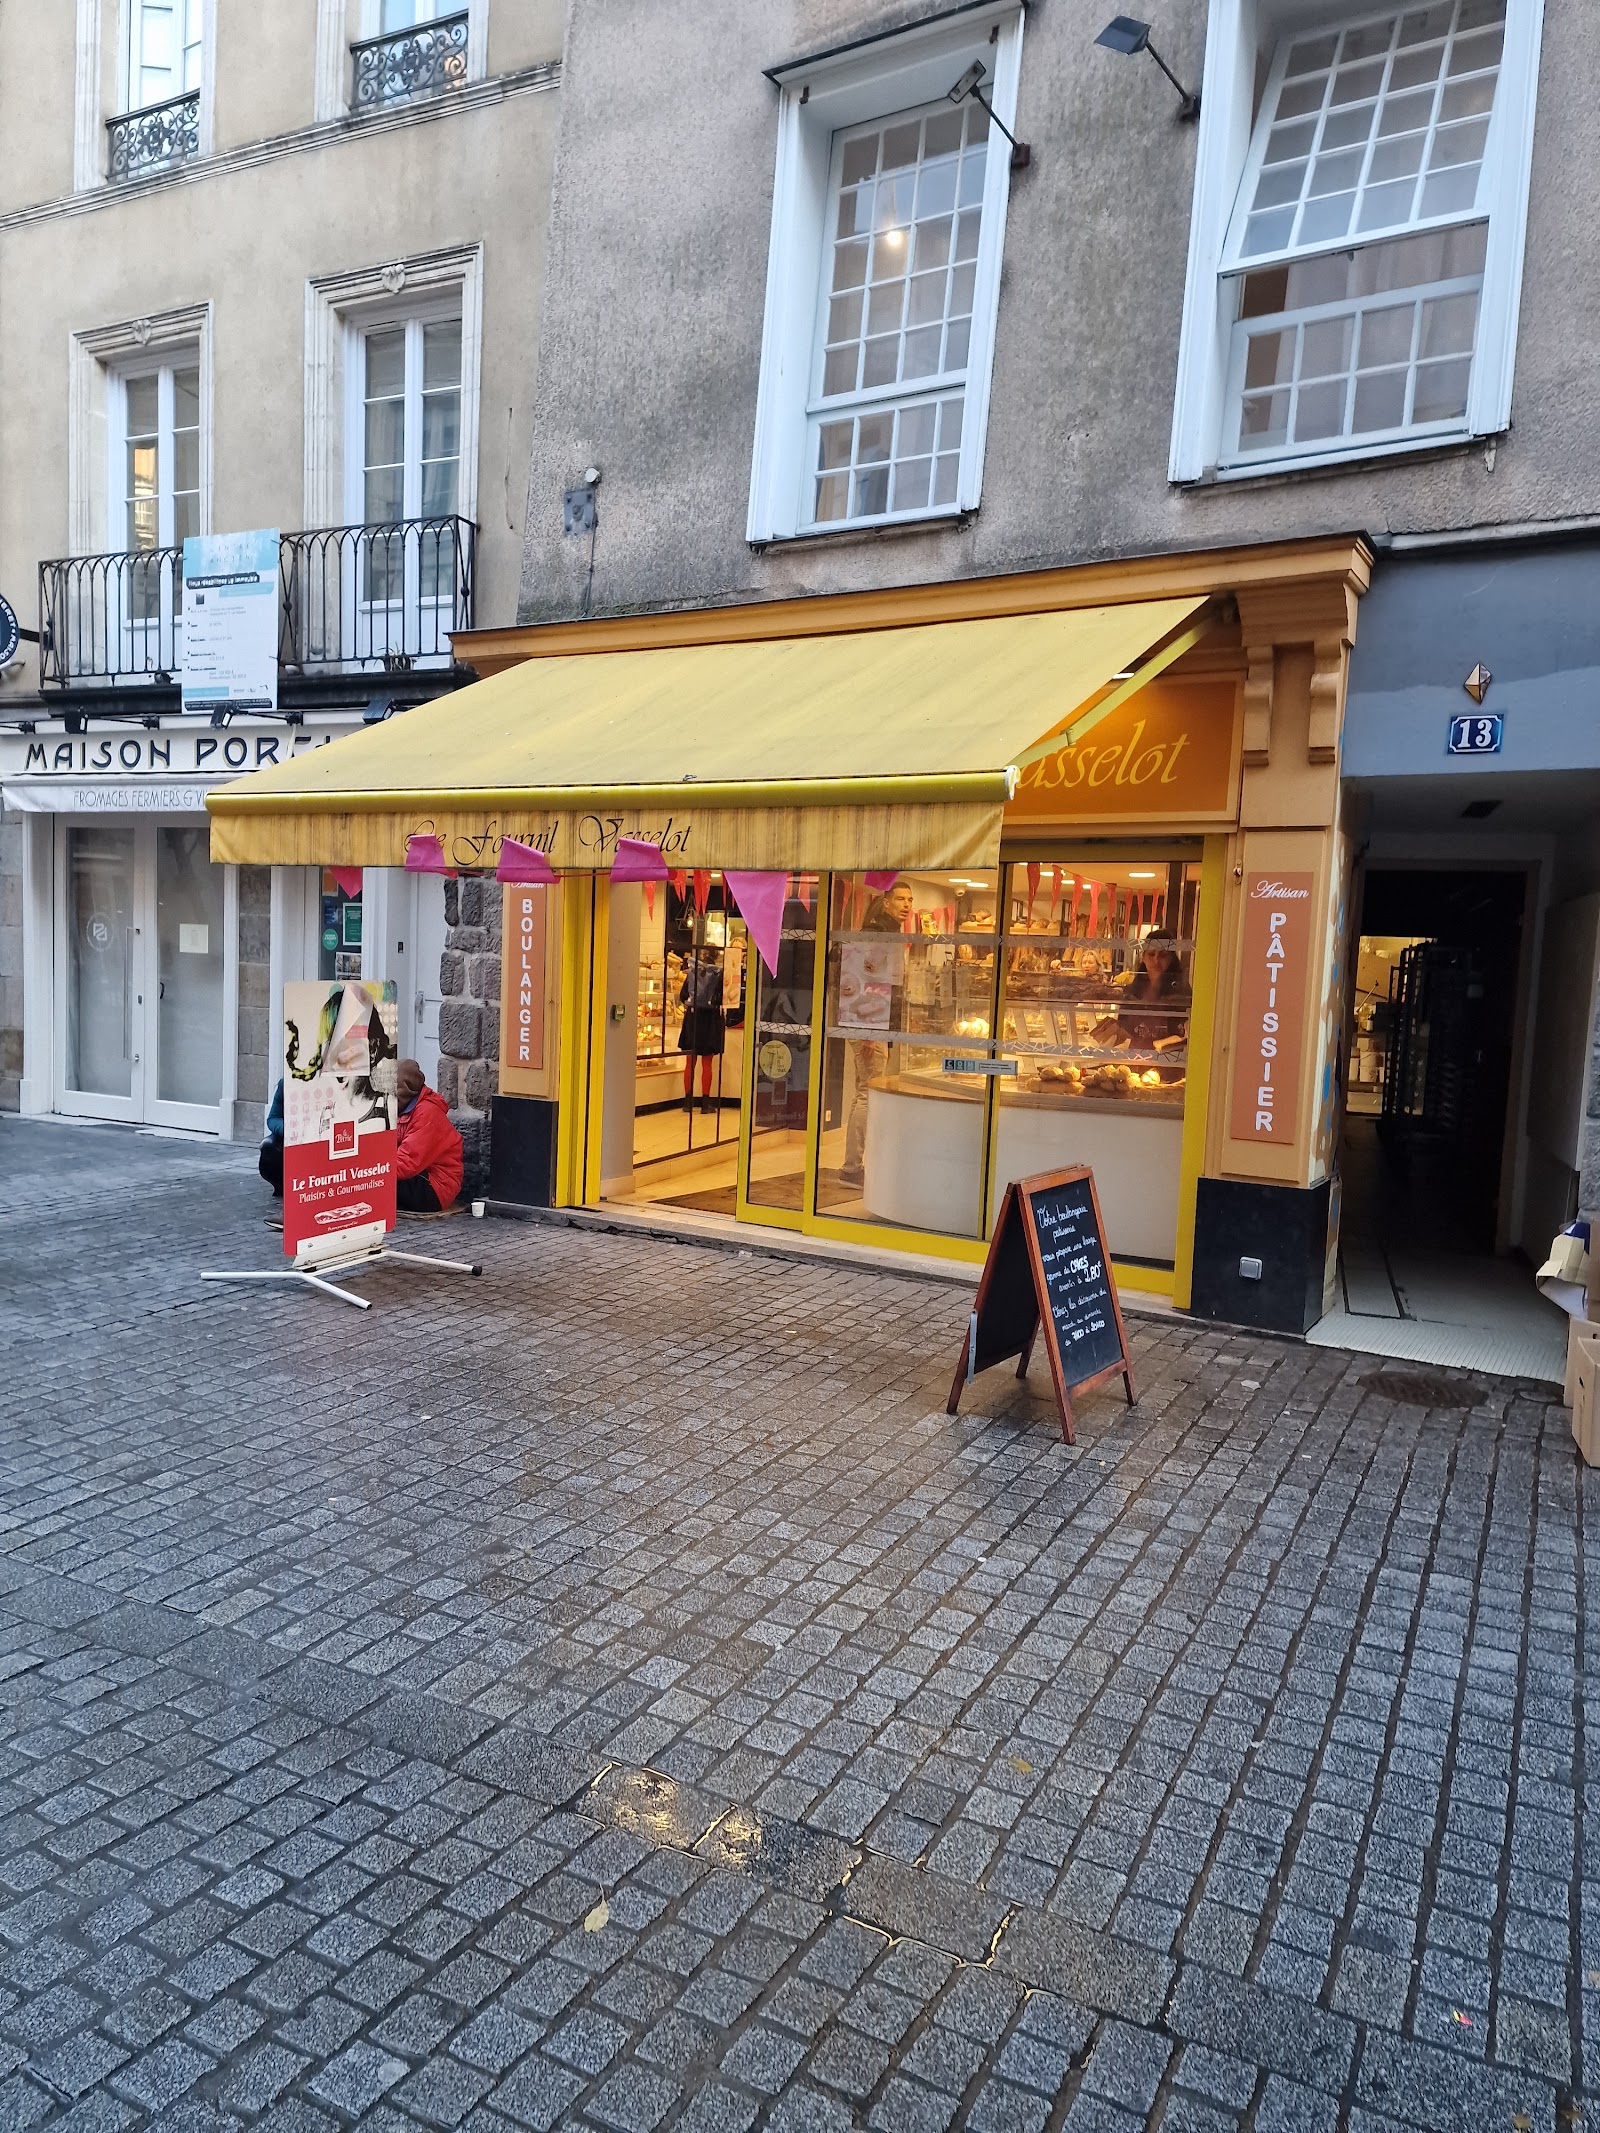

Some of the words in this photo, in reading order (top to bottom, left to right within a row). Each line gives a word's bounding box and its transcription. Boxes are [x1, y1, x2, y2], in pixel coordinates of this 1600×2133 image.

[1457, 719, 1493, 748] 13
[25, 738, 171, 771] MAISON
[1016, 719, 1191, 789] asselot
[73, 791, 129, 807] FROMAGES
[131, 789, 181, 807] FERMIERS
[578, 815, 692, 853] Vasselot
[1250, 880, 1309, 899] Artisan
[519, 898, 534, 1062] BOULANGER
[1255, 912, 1287, 1132] PÂTISSIER
[292, 1178, 305, 1192] Le
[308, 1169, 347, 1188] Fournil
[349, 1161, 391, 1180] Vasselot
[298, 1190, 326, 1204] Plaisirs
[327, 1187, 335, 1198] &
[336, 1178, 385, 1196] Gourmandises
[1070, 1255, 1089, 1273] CAKES
